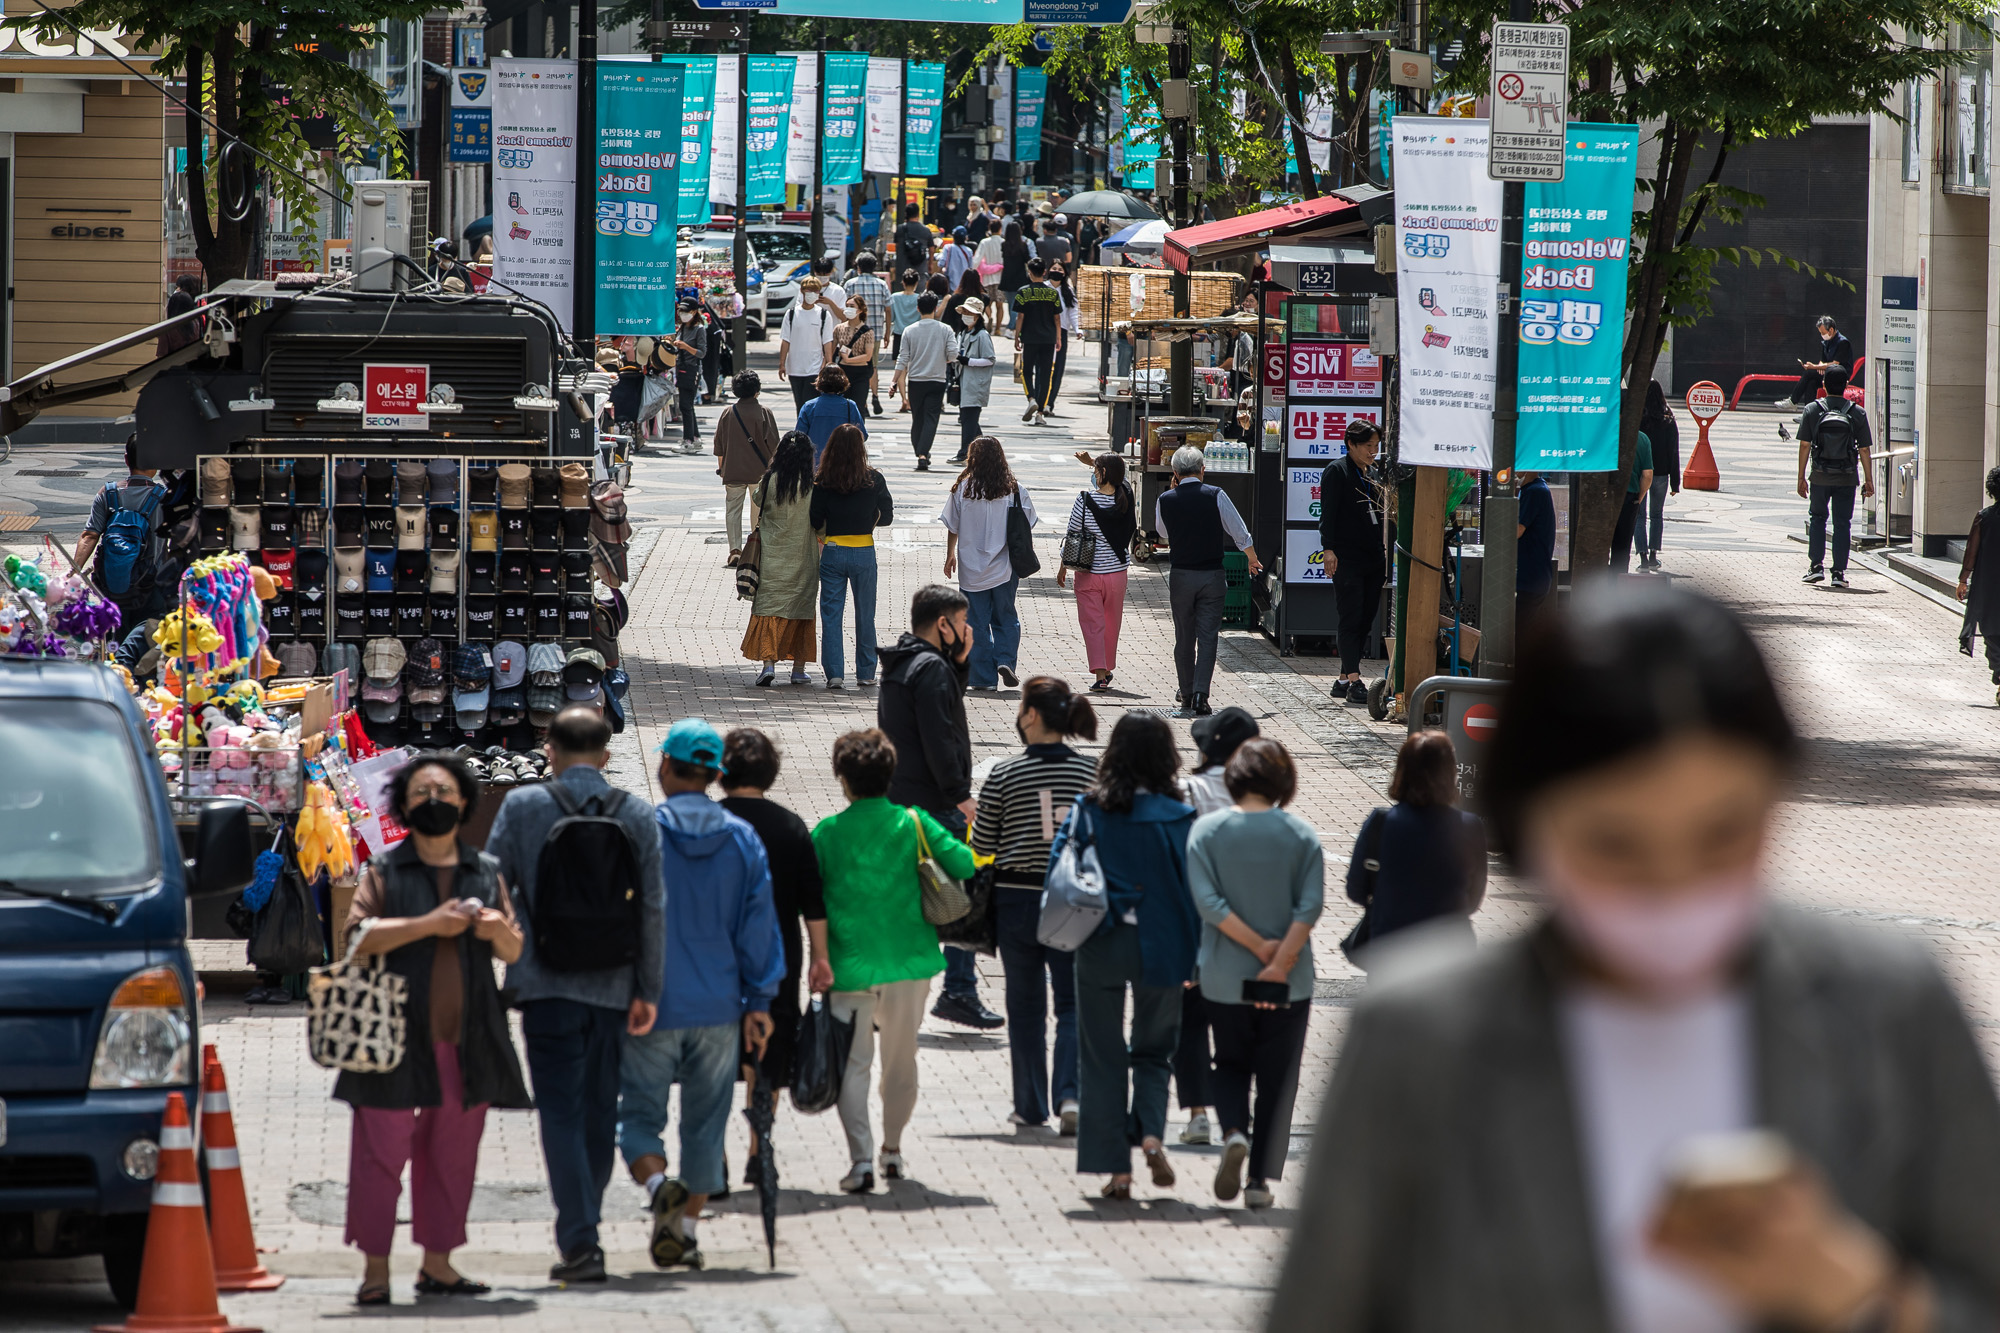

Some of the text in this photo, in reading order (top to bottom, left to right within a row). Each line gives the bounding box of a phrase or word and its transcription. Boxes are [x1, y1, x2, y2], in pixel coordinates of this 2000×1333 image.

[1029, 1, 1099, 12] Myeongdong 7-gil
[1499, 29, 1564, 46] 통행금지(제한)알림
[1499, 166, 1554, 176] 남대문경찰서장
[1301, 271, 1331, 284] 43-2
[1292, 352, 1339, 375] SIM
[376, 382, 418, 400] 에스원
[1692, 393, 1721, 404] 주차금지
[366, 417, 400, 426] SECOM
[1308, 444, 1329, 455] 사고
[270, 523, 286, 531] BTS
[371, 520, 392, 530] NYC
[268, 561, 291, 571] KOREA
[374, 561, 388, 575] LA
[272, 606, 290, 617] 친구
[540, 608, 558, 618] 최고
